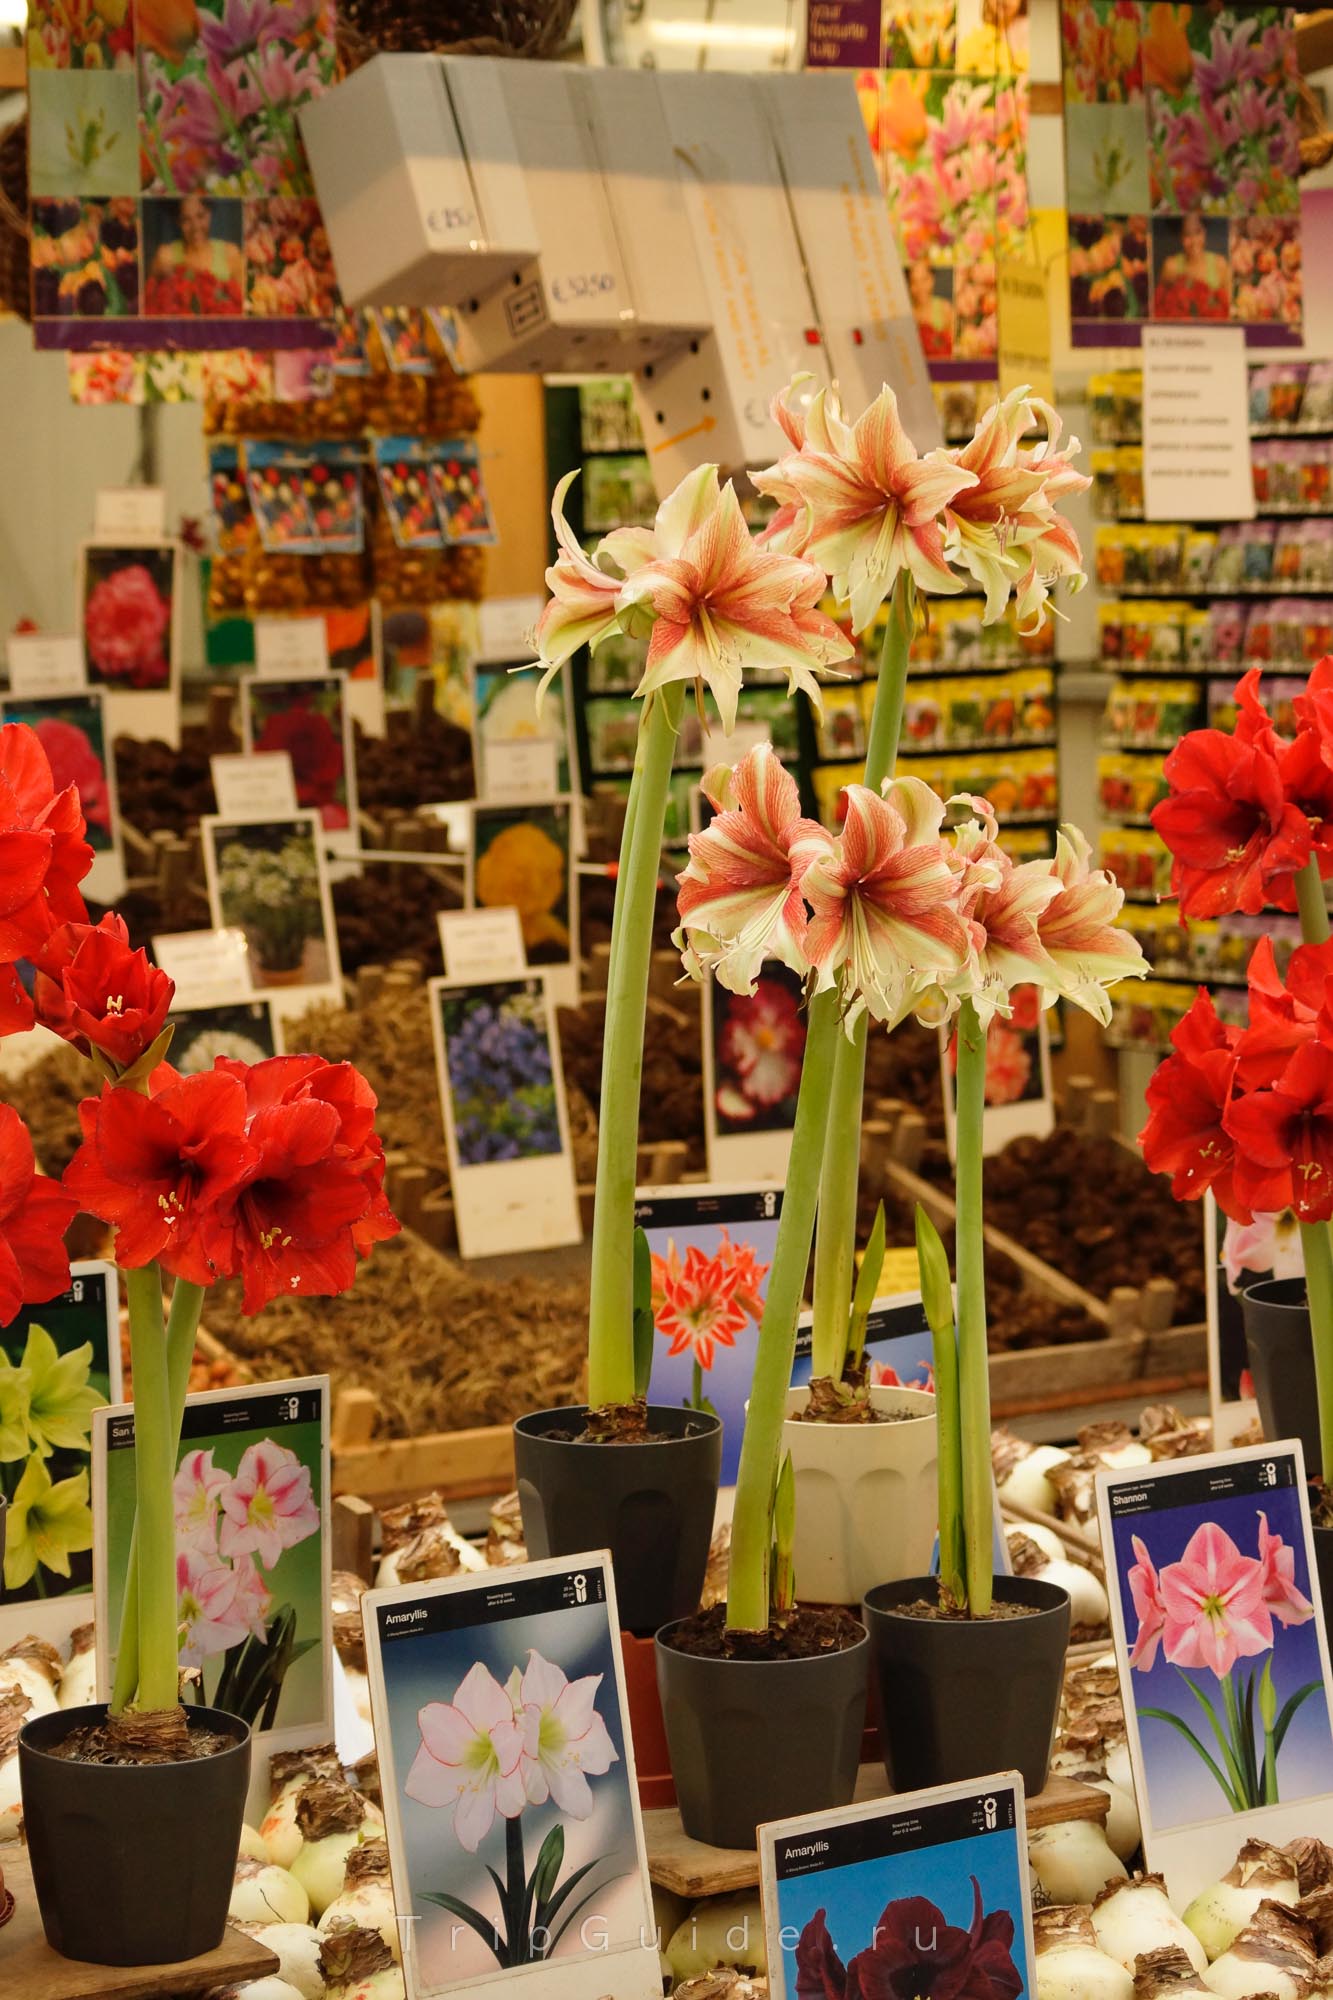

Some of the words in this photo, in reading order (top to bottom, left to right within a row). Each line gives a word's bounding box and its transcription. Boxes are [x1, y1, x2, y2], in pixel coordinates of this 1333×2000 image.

[112, 1428, 130, 1438] San
[1113, 1492, 1148, 1506] Shannon
[385, 1608, 428, 1625] Amaryllis
[784, 1840, 829, 1860] Amaryllis
